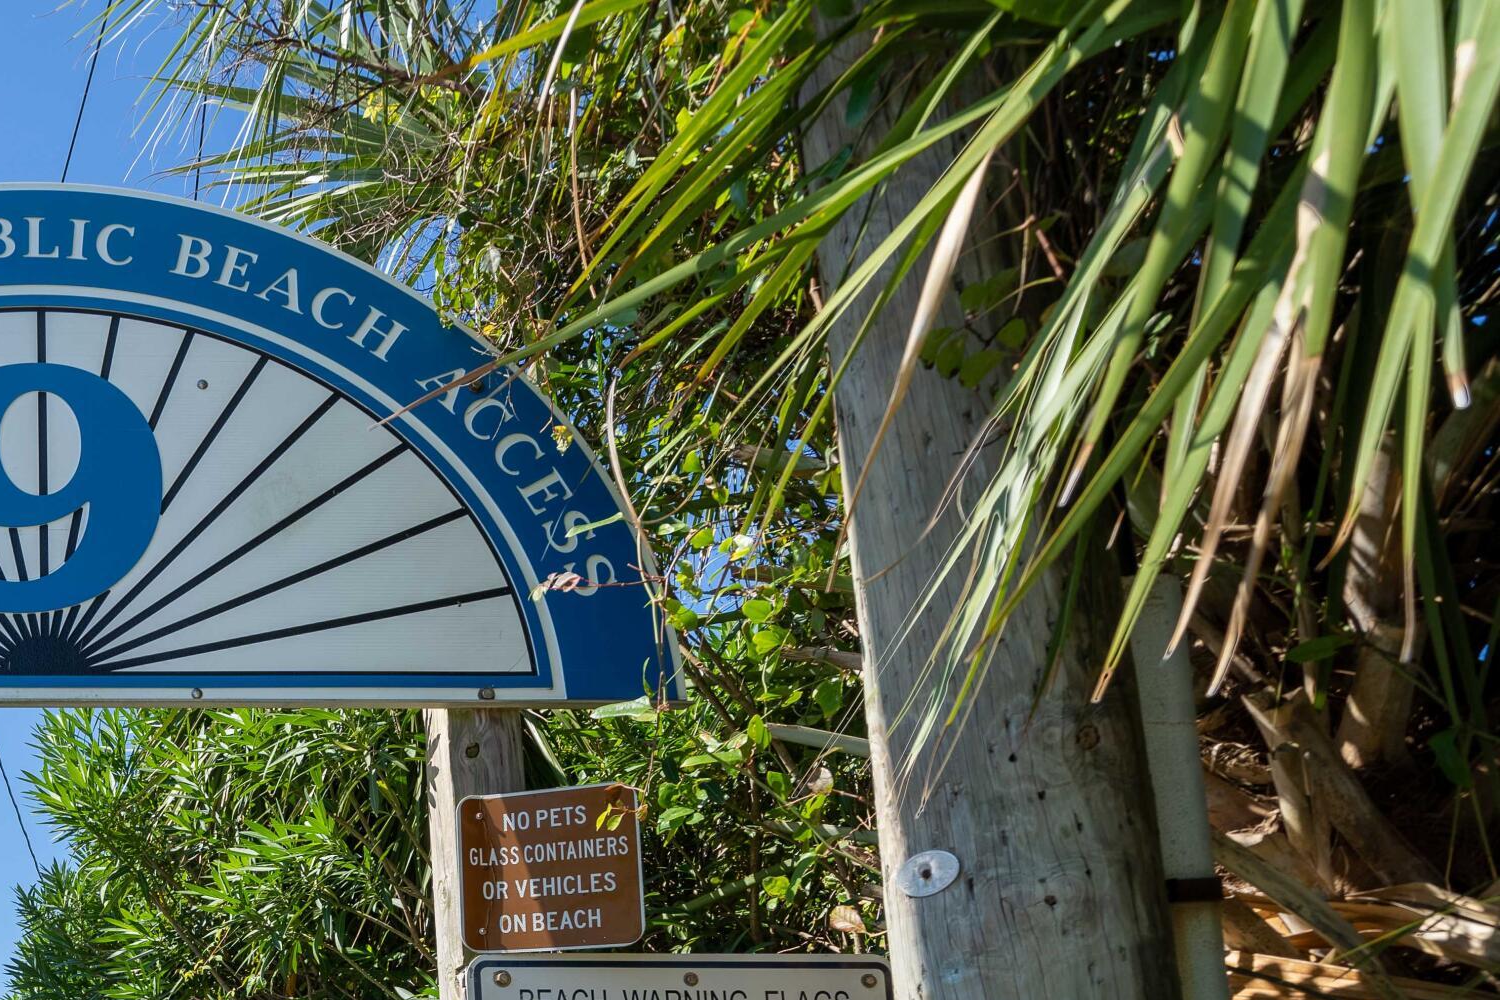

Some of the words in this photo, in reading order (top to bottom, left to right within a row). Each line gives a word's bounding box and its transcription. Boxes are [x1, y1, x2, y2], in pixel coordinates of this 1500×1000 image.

[169, 233, 409, 363] BEACH
[414, 368, 617, 596] ACCESS
[503, 811, 529, 832] NO
[536, 805, 587, 828] PETS
[469, 846, 519, 866] GLASS
[524, 835, 628, 863] CONTAINERS
[483, 881, 508, 900] OR
[515, 872, 617, 898] VEHICLES
[500, 913, 526, 933] ON
[532, 908, 601, 931] BEACH
